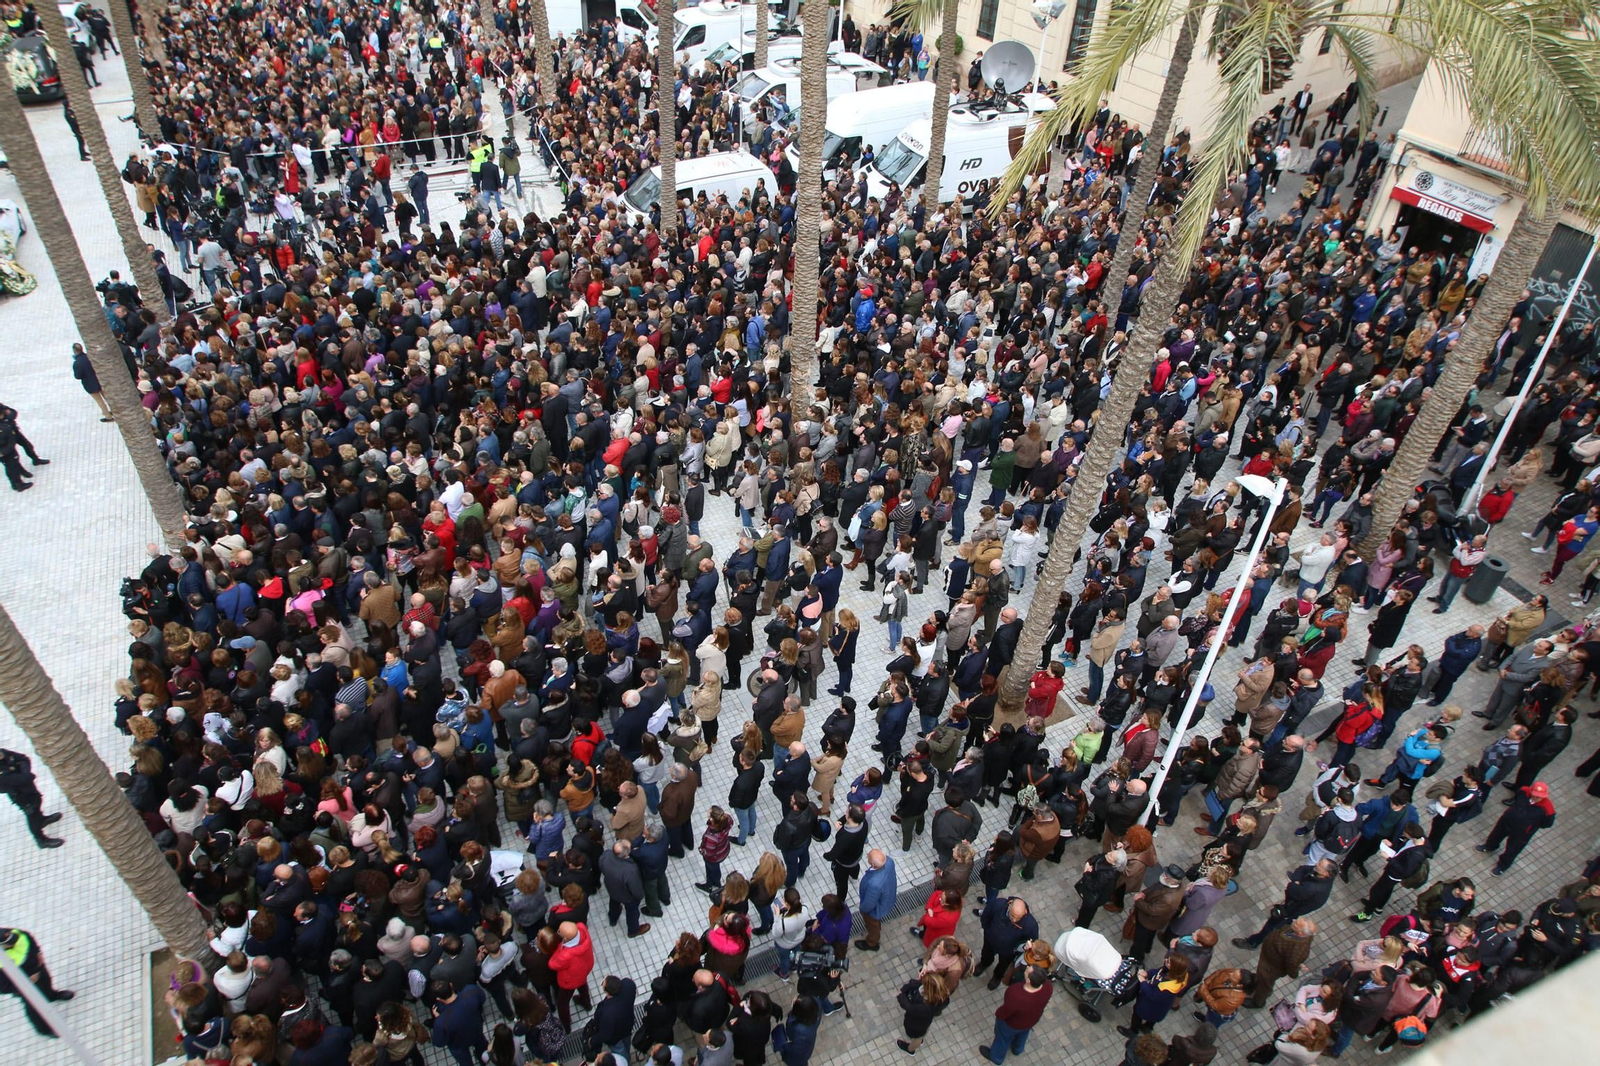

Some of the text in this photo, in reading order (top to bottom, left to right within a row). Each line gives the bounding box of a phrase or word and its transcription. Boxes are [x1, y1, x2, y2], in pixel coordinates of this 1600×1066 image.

[959, 157, 982, 170] HD
[1437, 187, 1458, 202] Rey
[1417, 198, 1463, 222] REGALOS
